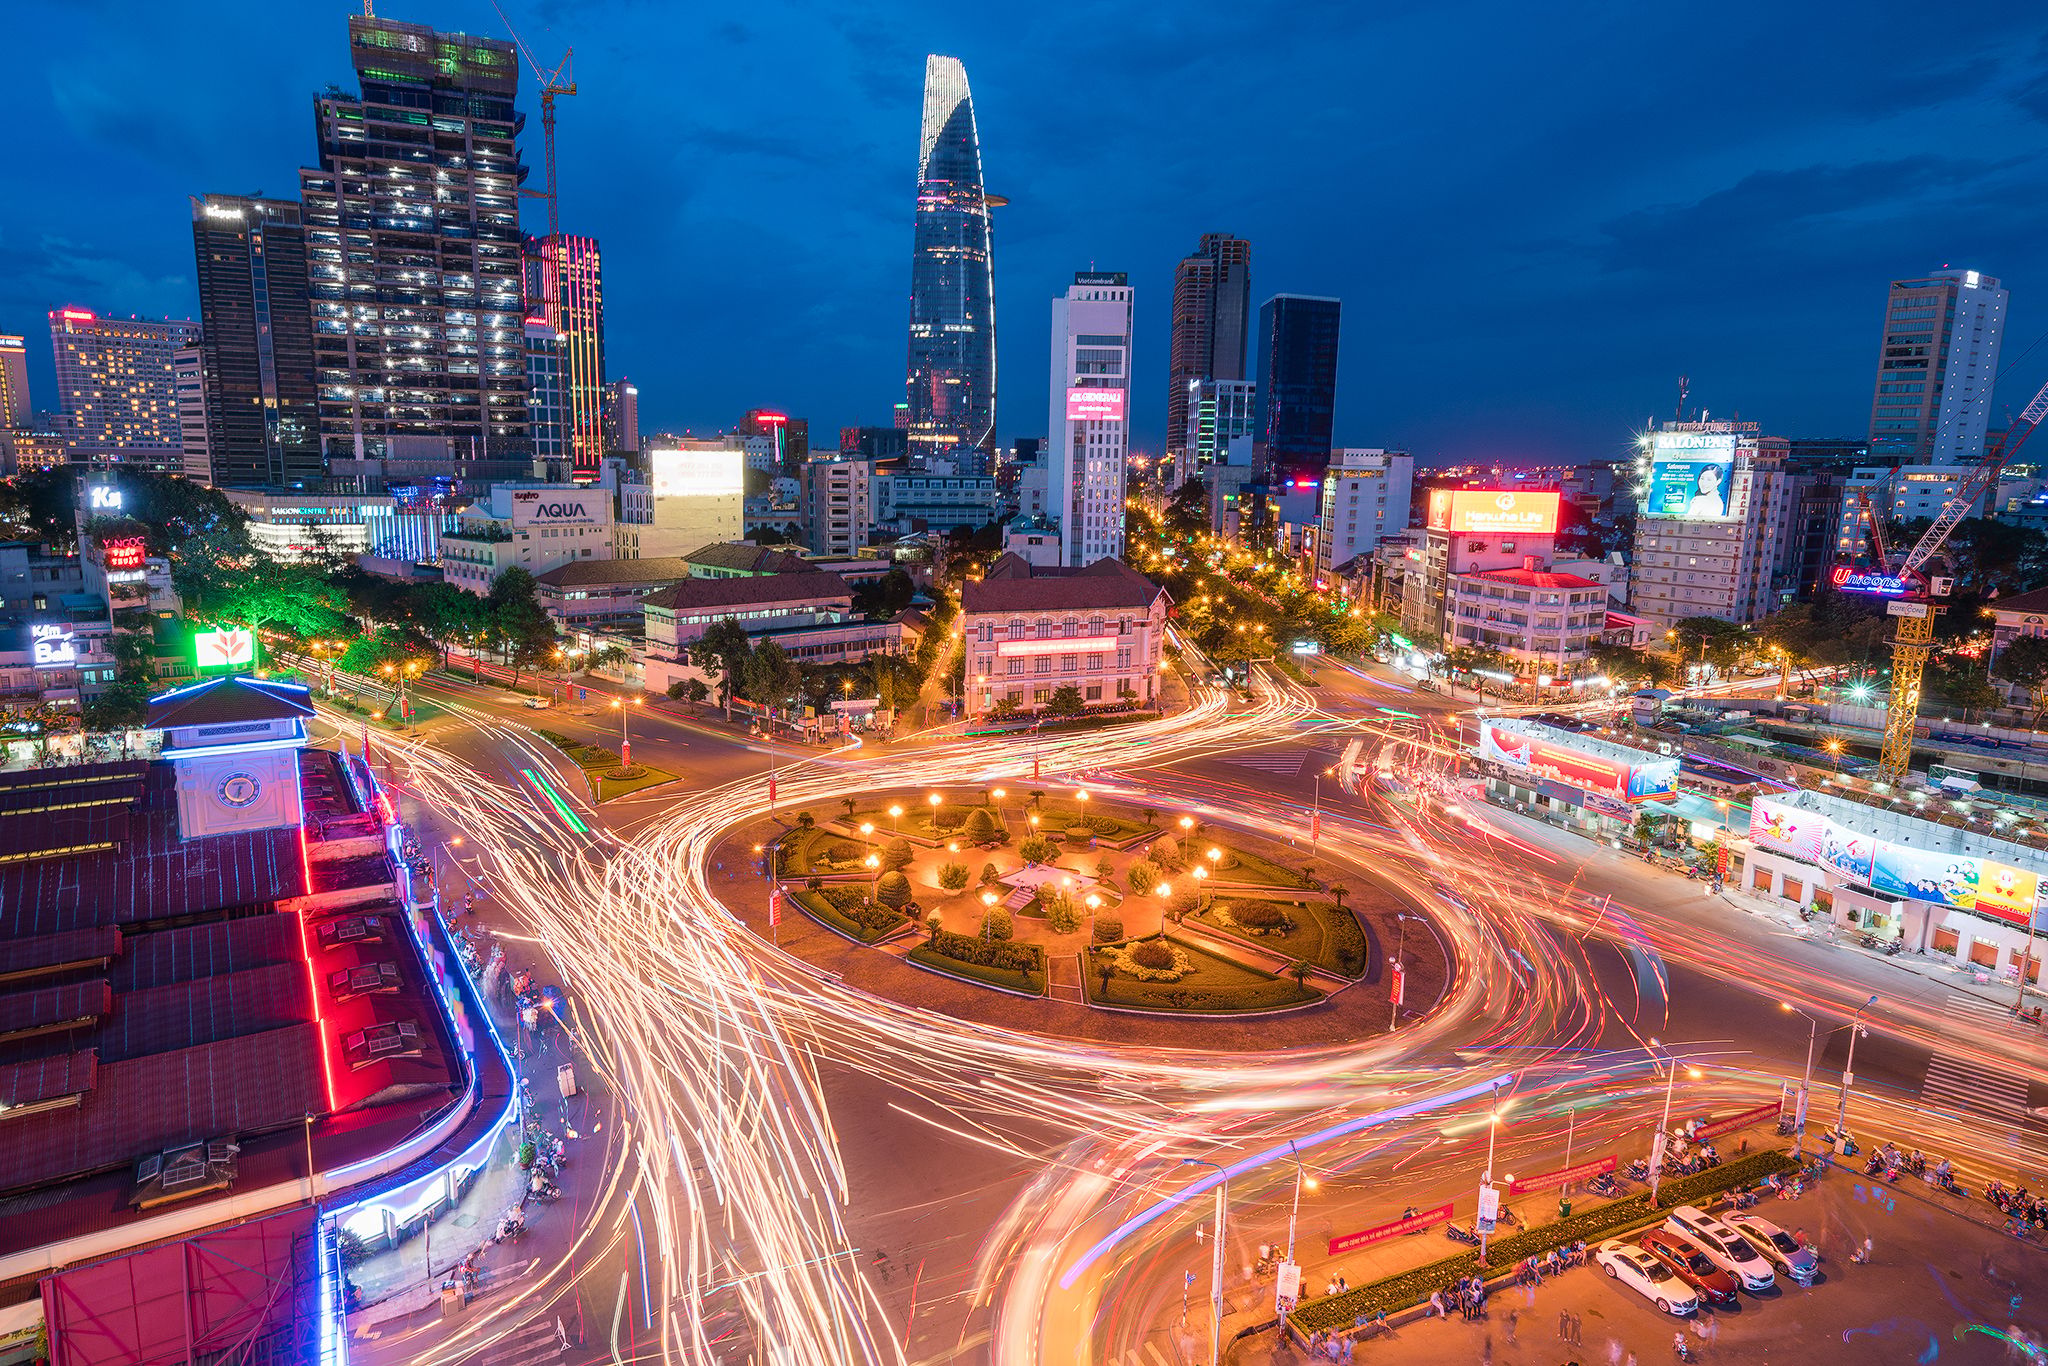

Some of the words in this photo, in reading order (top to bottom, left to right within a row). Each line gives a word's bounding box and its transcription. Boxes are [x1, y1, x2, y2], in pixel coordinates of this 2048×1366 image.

[1730, 421, 1760, 432] HOTEL
[1658, 434, 1734, 449] SALONPAS
[536, 503, 587, 517] AQUA
[1520, 512, 1544, 522] Life
[1833, 568, 1902, 588] Unicons
